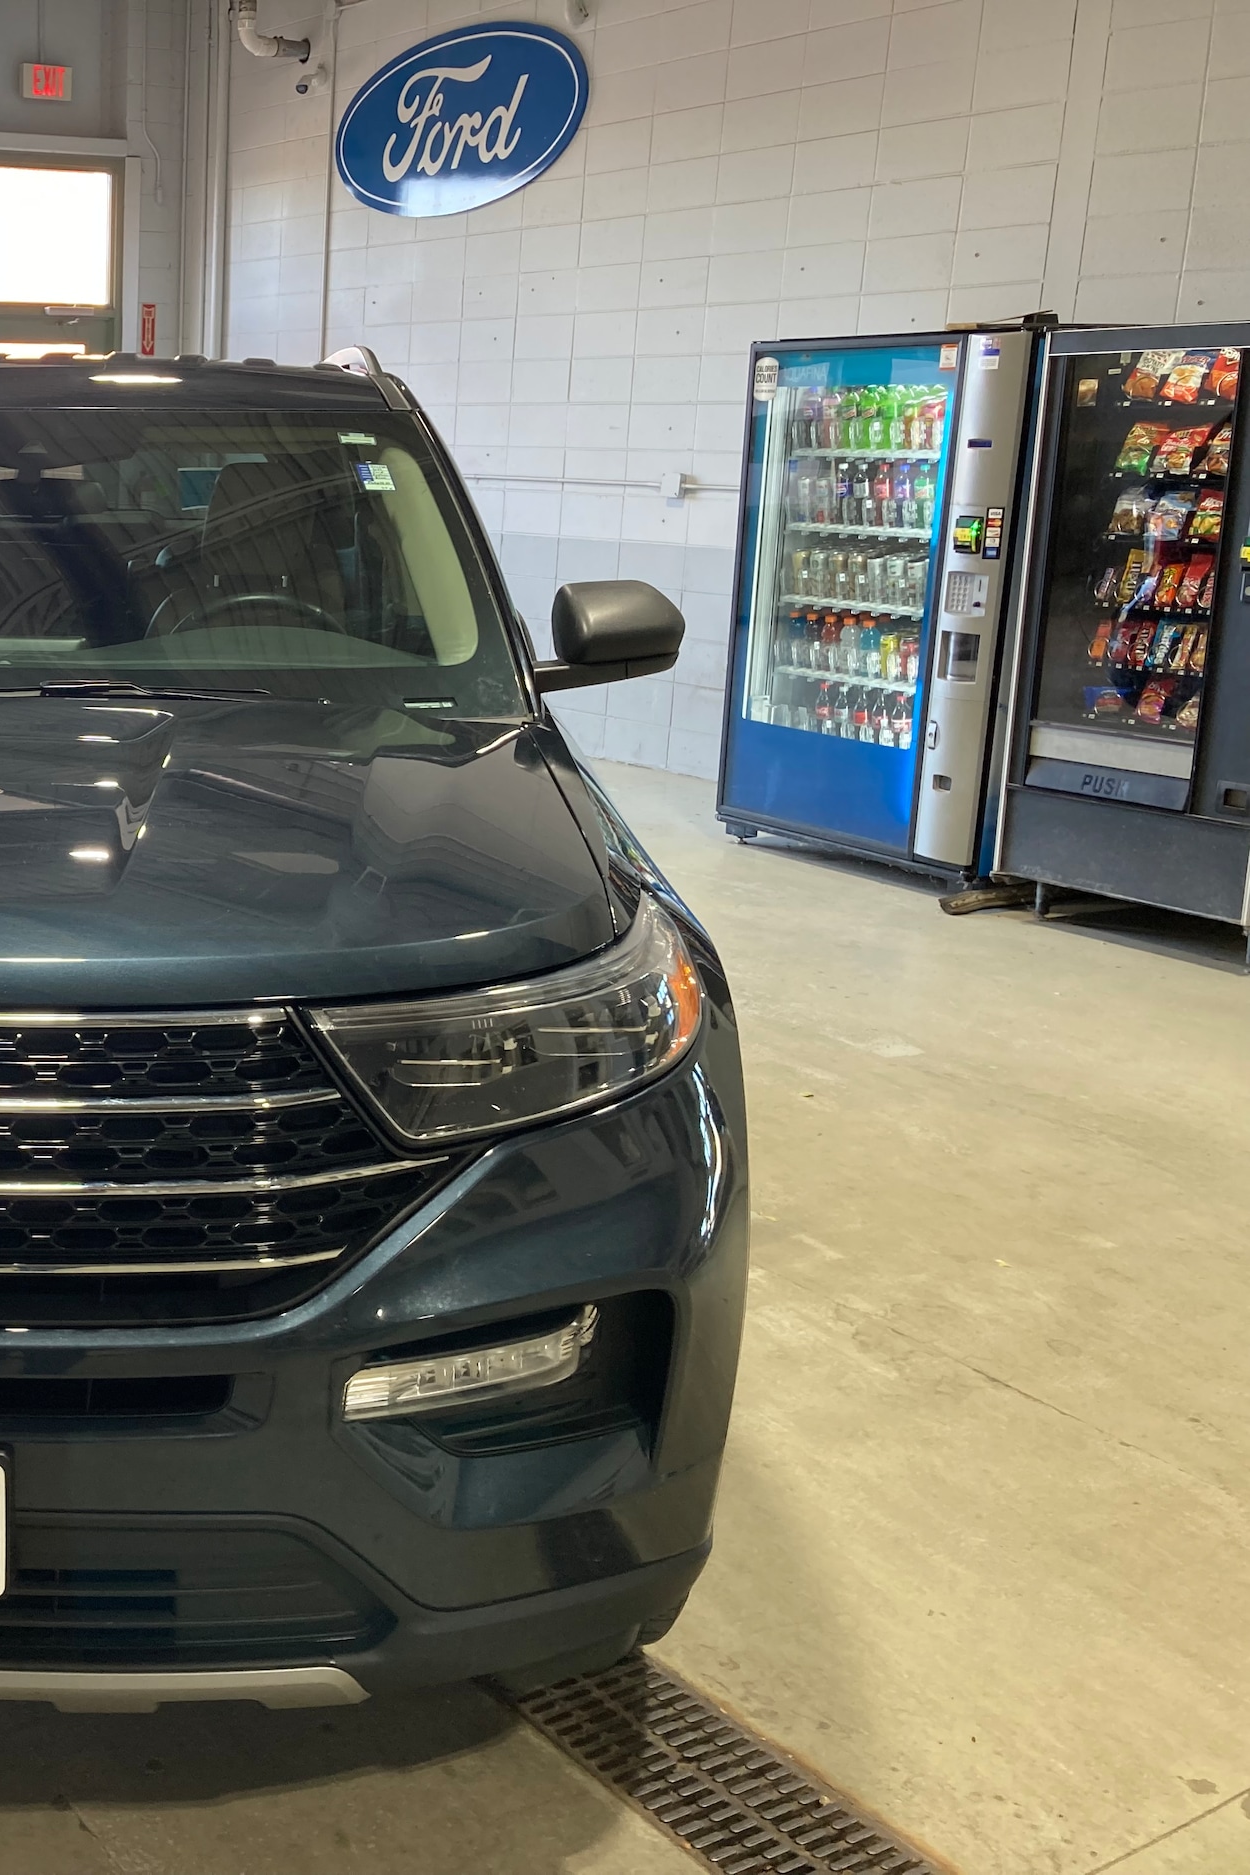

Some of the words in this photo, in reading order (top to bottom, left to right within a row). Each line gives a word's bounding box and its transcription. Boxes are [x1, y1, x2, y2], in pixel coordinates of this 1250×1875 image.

[33, 64, 66, 98] EXIT
[382, 54, 530, 183] Ford
[755, 373, 777, 384] COUNT
[756, 365, 778, 373] CALORIES
